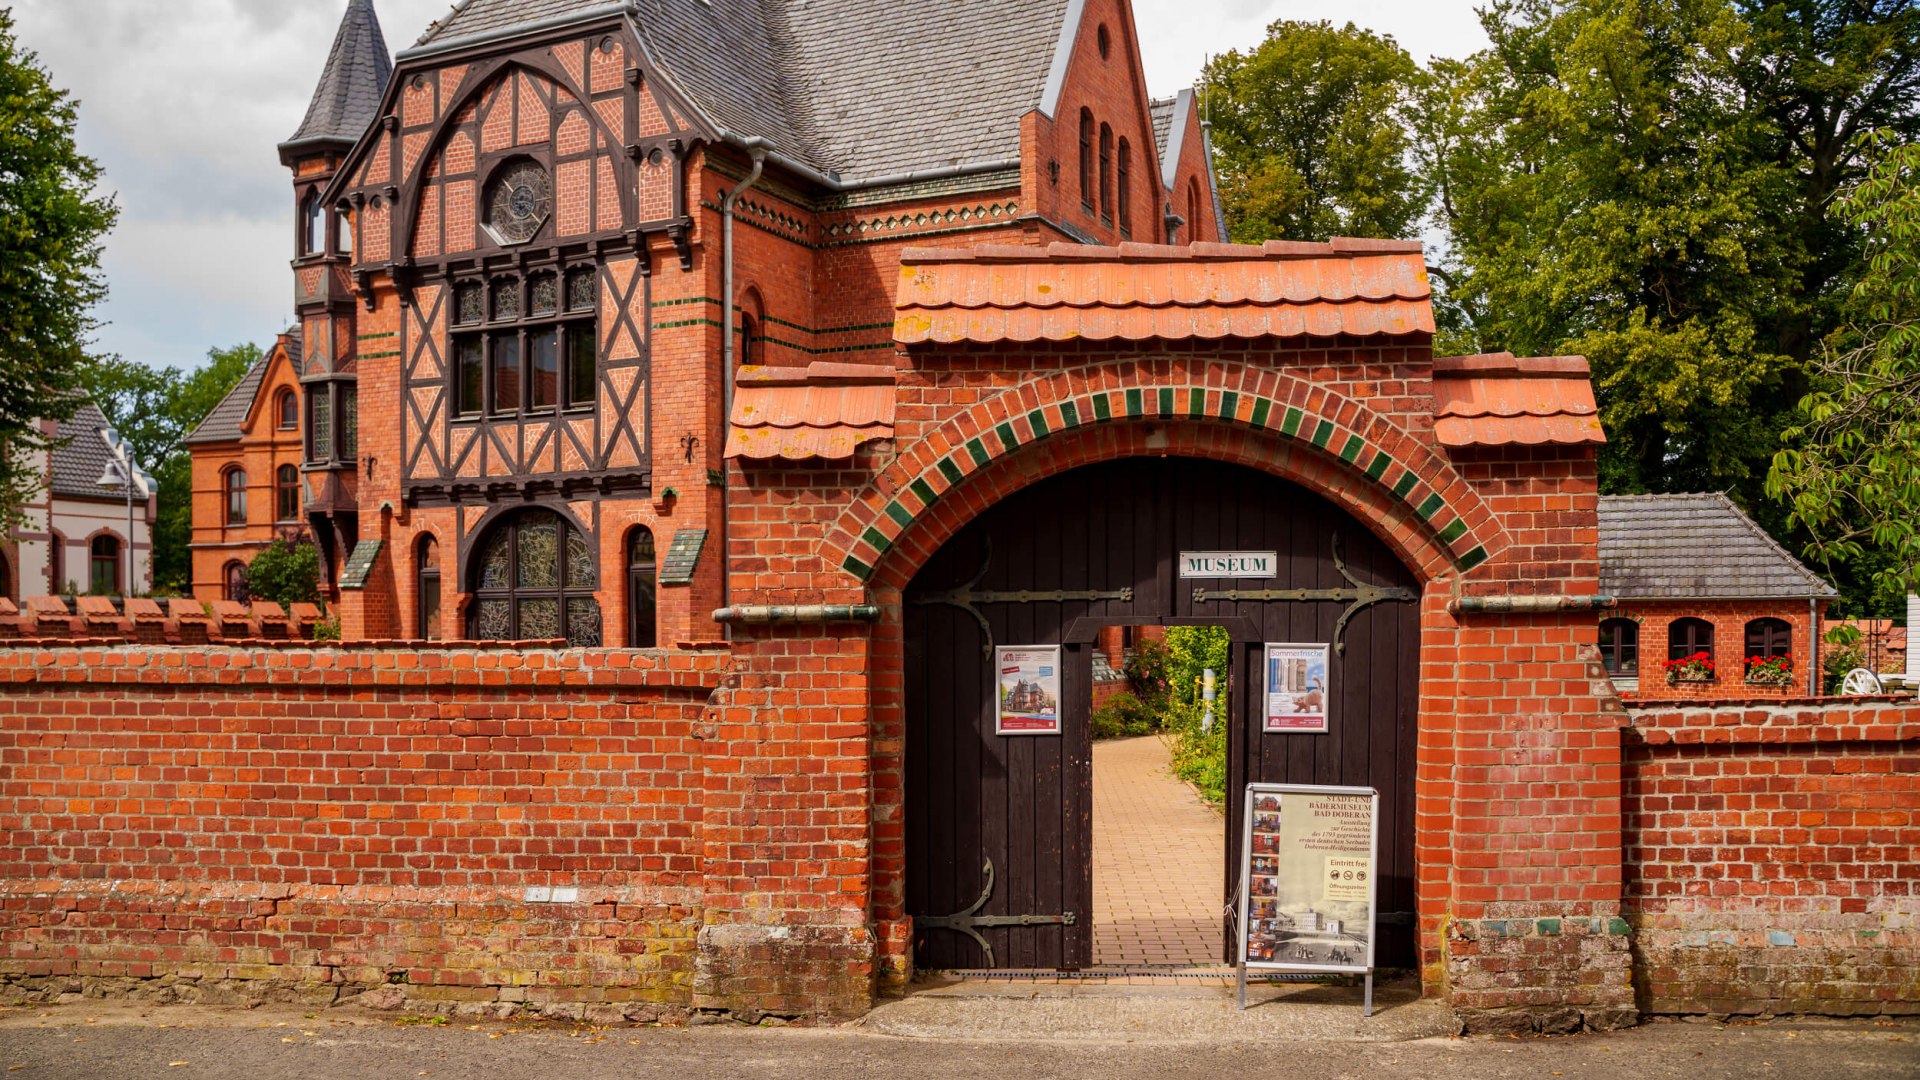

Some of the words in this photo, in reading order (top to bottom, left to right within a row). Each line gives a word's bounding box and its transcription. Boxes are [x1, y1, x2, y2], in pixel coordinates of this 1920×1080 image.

[1188, 558, 1267, 572] MUSEUM
[1271, 649, 1323, 657] Sommerfrische
[1309, 801, 1371, 811] BÄDERMUSEUM
[1332, 811, 1371, 819] DOBERAN
[1330, 859, 1354, 867] Eintritt
[1355, 860, 1367, 868] frei
